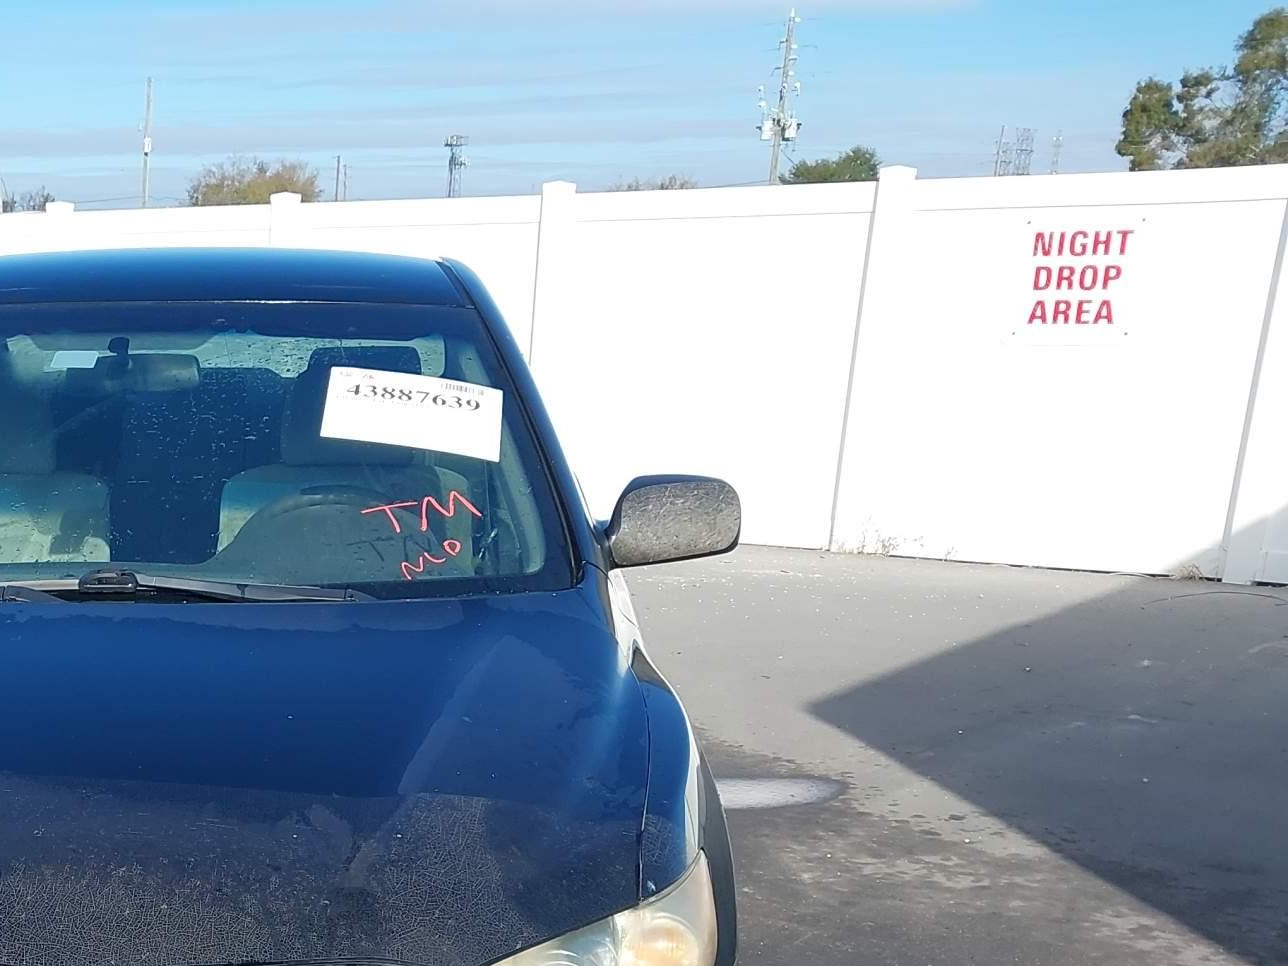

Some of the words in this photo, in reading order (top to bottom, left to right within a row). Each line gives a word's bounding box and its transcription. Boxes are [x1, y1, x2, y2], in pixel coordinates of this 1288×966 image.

[1032, 229, 1135, 257] NIGHT
[1032, 264, 1123, 291] DROP
[1027, 299, 1114, 325] AREA
[346, 383, 481, 411] 43887639
[360, 490, 483, 533] TM
